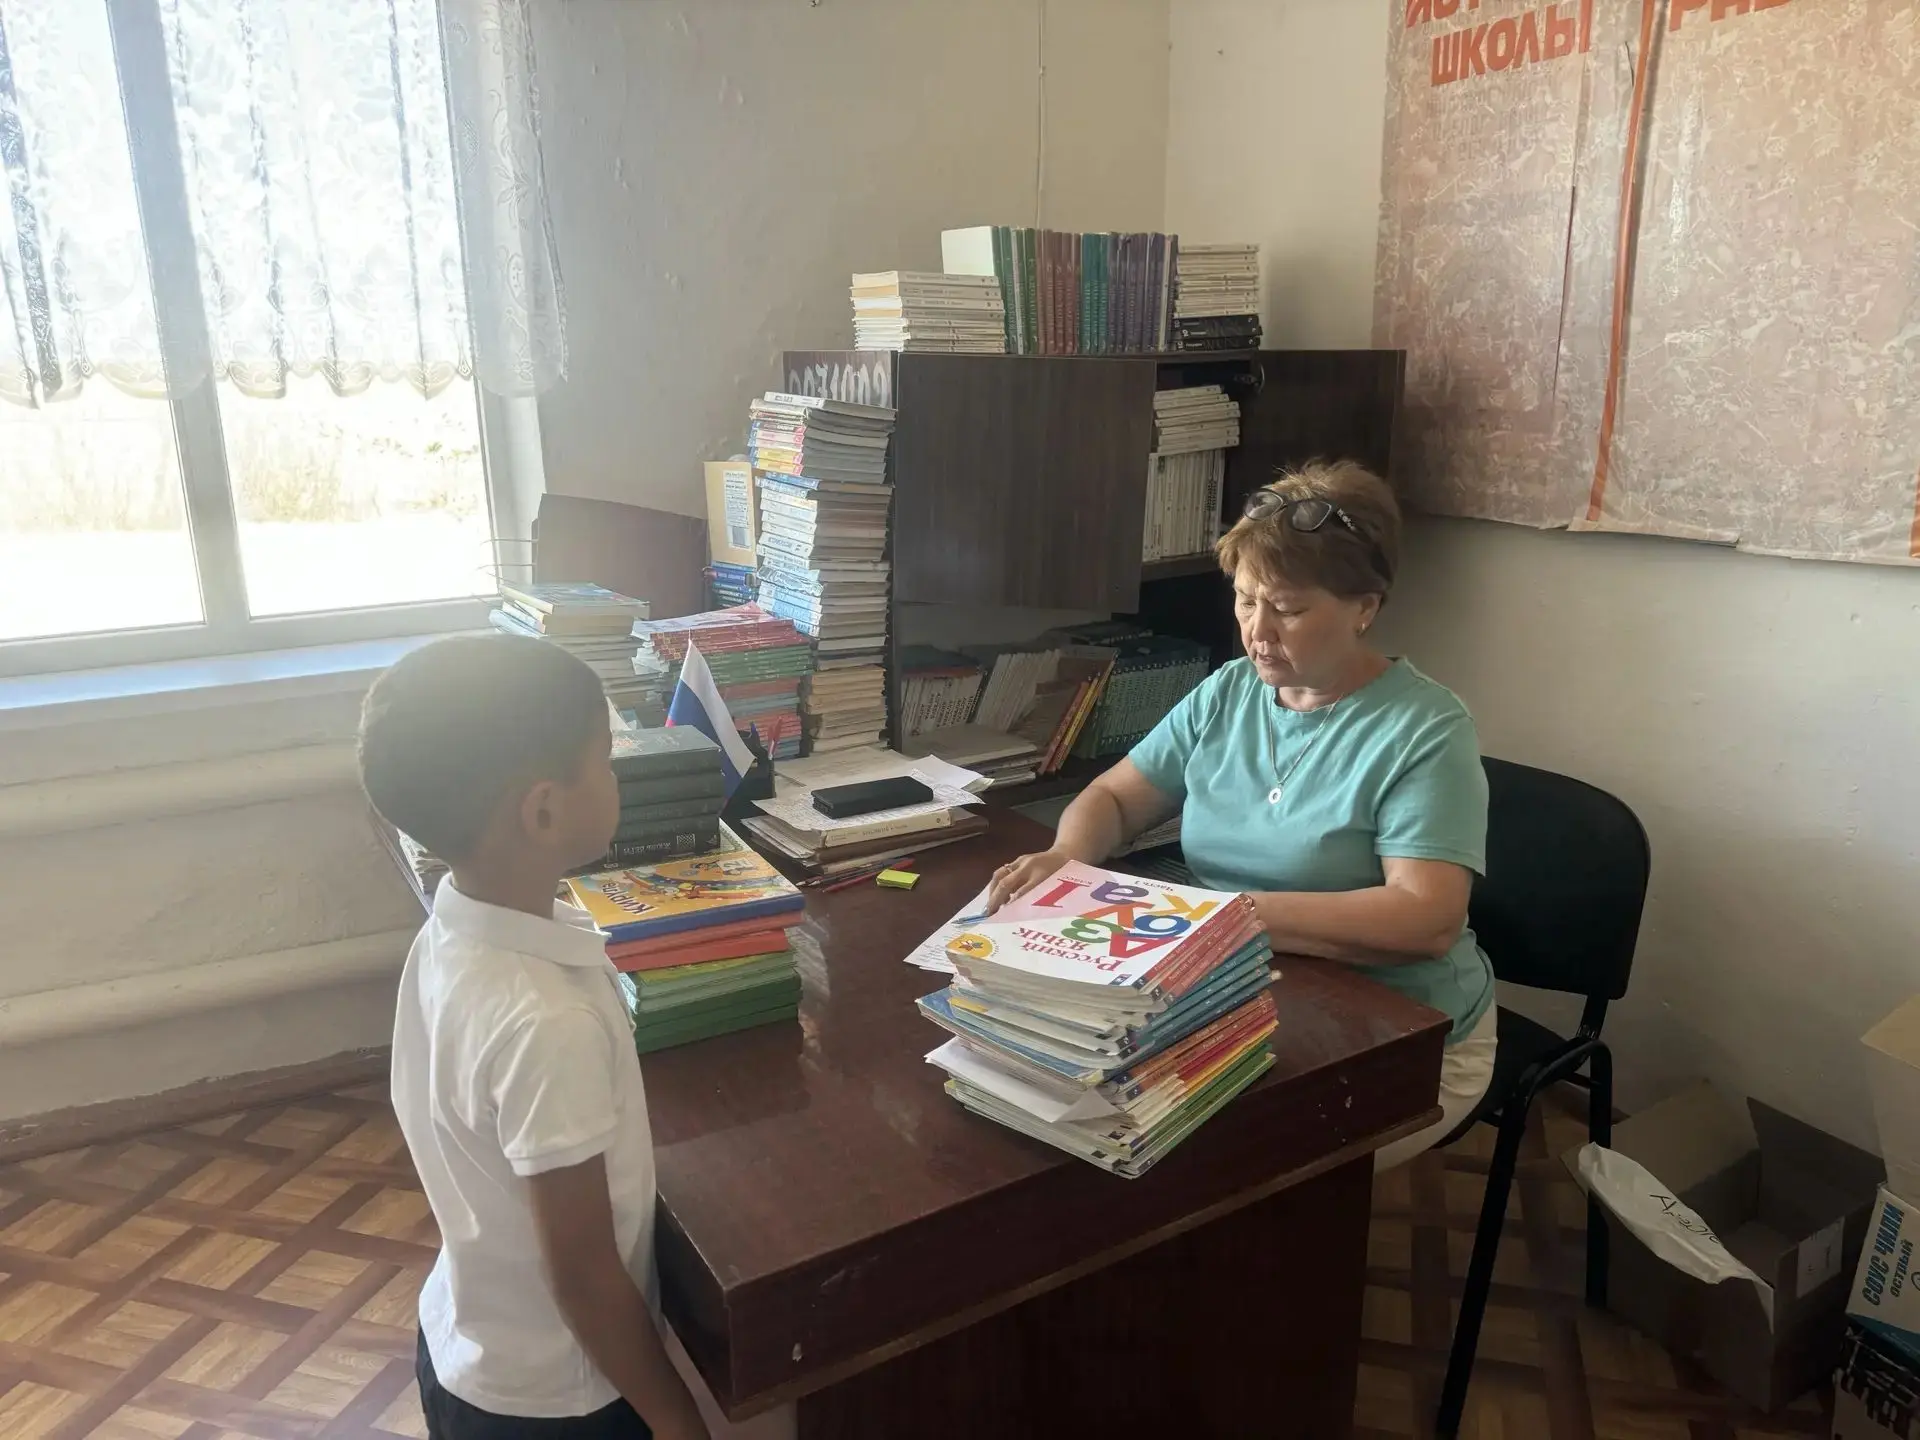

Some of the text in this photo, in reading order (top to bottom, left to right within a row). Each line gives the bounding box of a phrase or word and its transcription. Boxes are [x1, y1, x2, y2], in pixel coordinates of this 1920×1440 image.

[1431, 0, 1592, 87] ШКОЛЫ
[1031, 878, 1090, 909] 1
[1012, 927, 1090, 952] язык
[1021, 942, 1127, 972] Русский
[1862, 1202, 1905, 1306] СОУС ЧИЛИ
